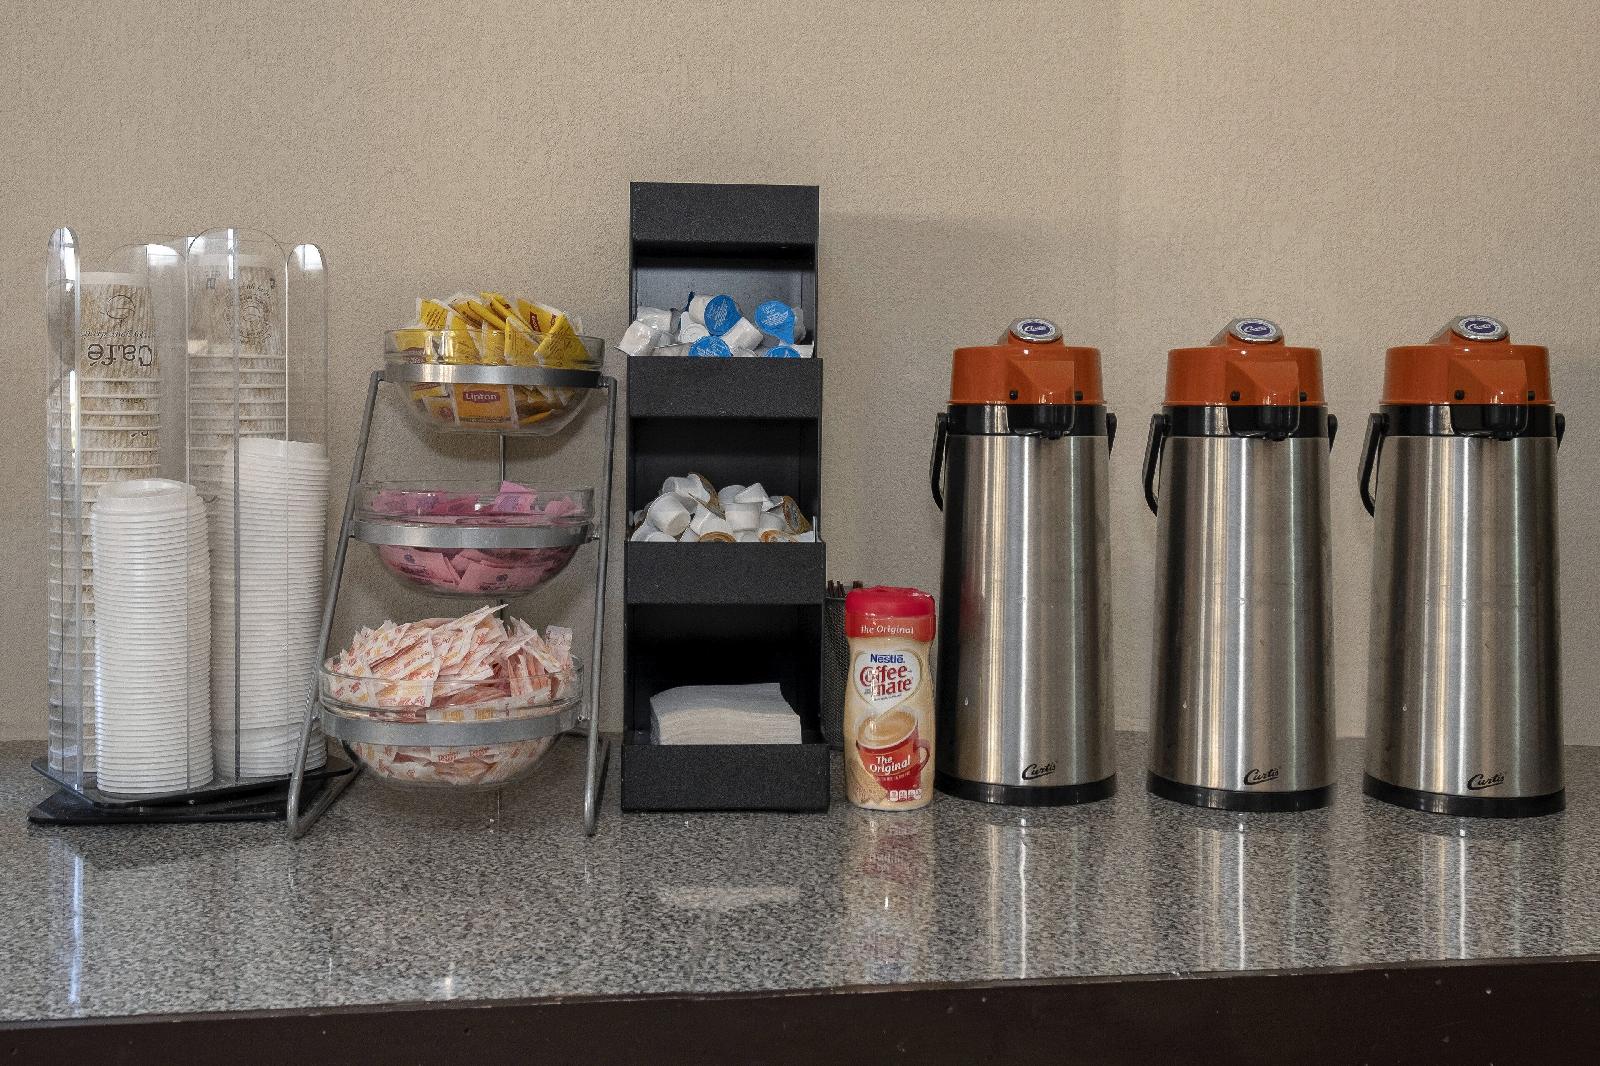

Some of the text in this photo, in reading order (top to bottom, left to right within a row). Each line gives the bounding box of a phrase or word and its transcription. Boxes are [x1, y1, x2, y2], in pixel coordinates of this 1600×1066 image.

[87, 343, 153, 367] Café
[465, 393, 497, 401] Lipton
[876, 625, 914, 635] Original
[870, 754, 911, 776] Original
[876, 755, 893, 765] The
[1022, 763, 1056, 780] Curtis
[1244, 768, 1279, 785] Curtis
[1467, 773, 1504, 790] Curtis
